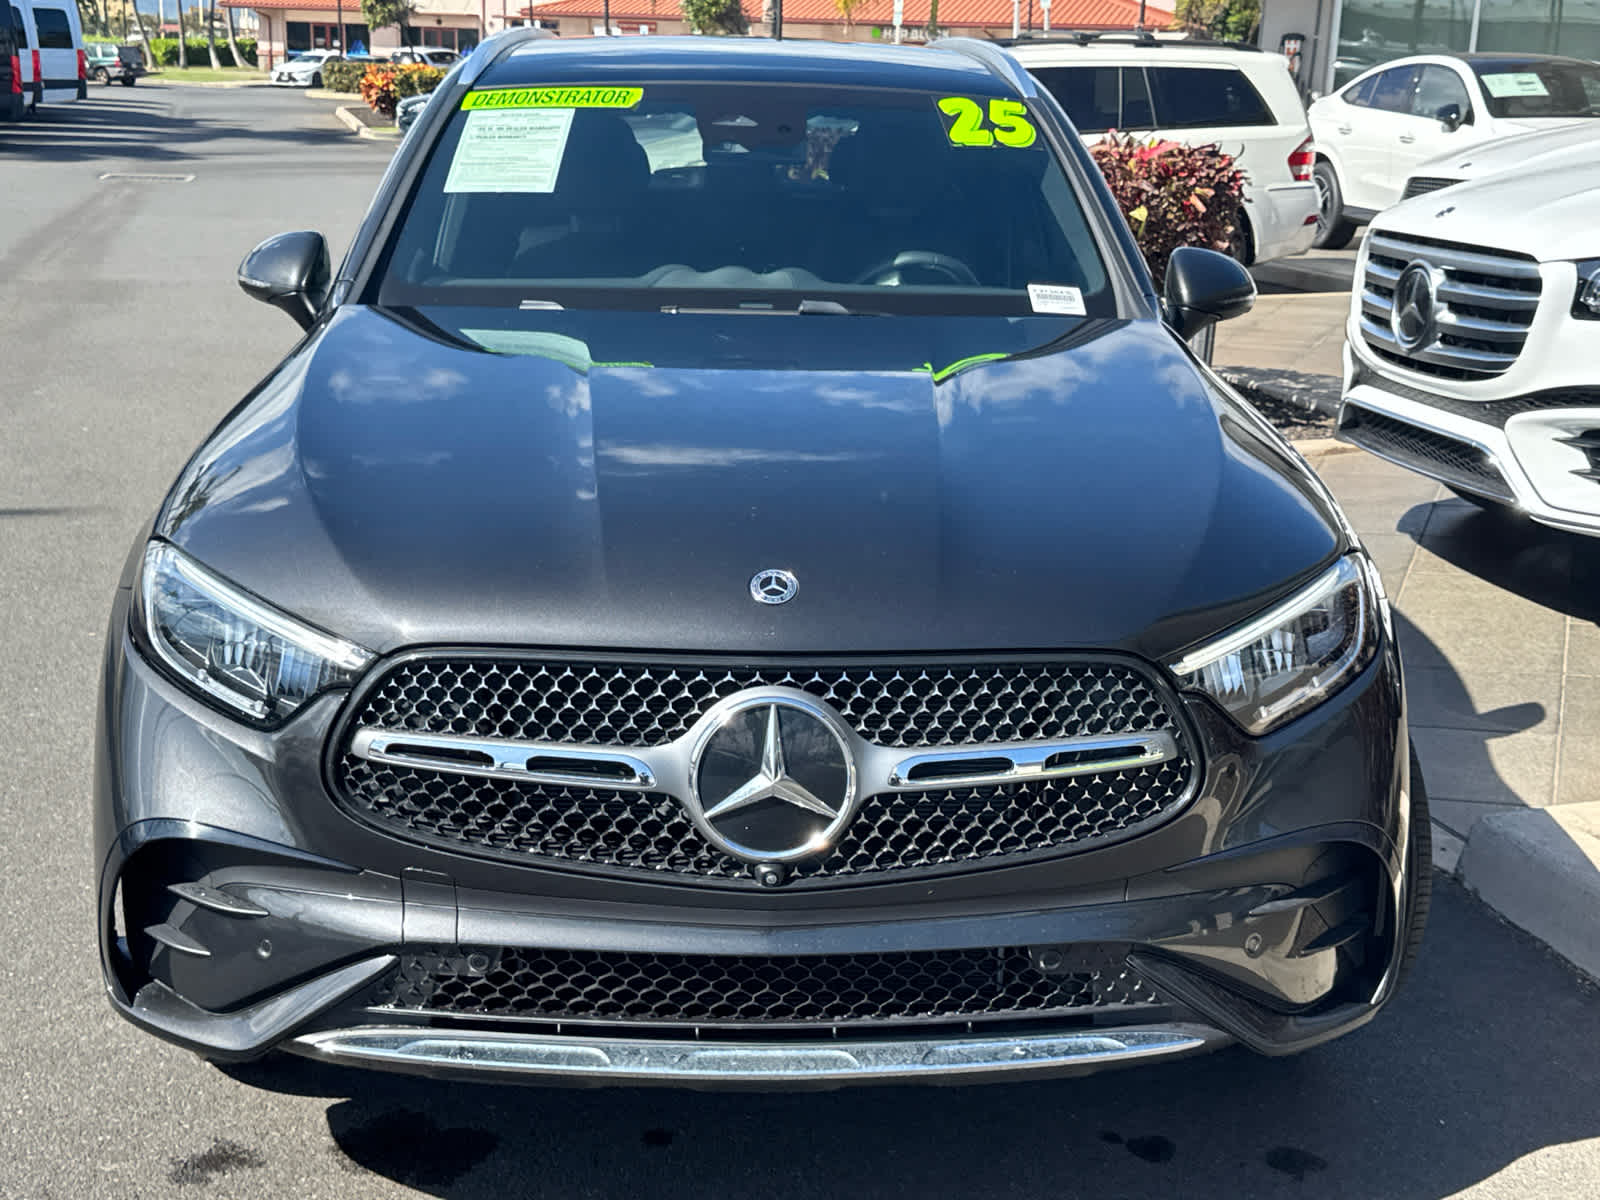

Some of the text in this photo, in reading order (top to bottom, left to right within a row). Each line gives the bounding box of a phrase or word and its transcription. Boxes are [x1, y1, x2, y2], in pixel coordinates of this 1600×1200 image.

[883, 27, 909, 41] HR
[471, 89, 631, 107] DEMONSTRATOR
[937, 96, 1037, 148] 25
